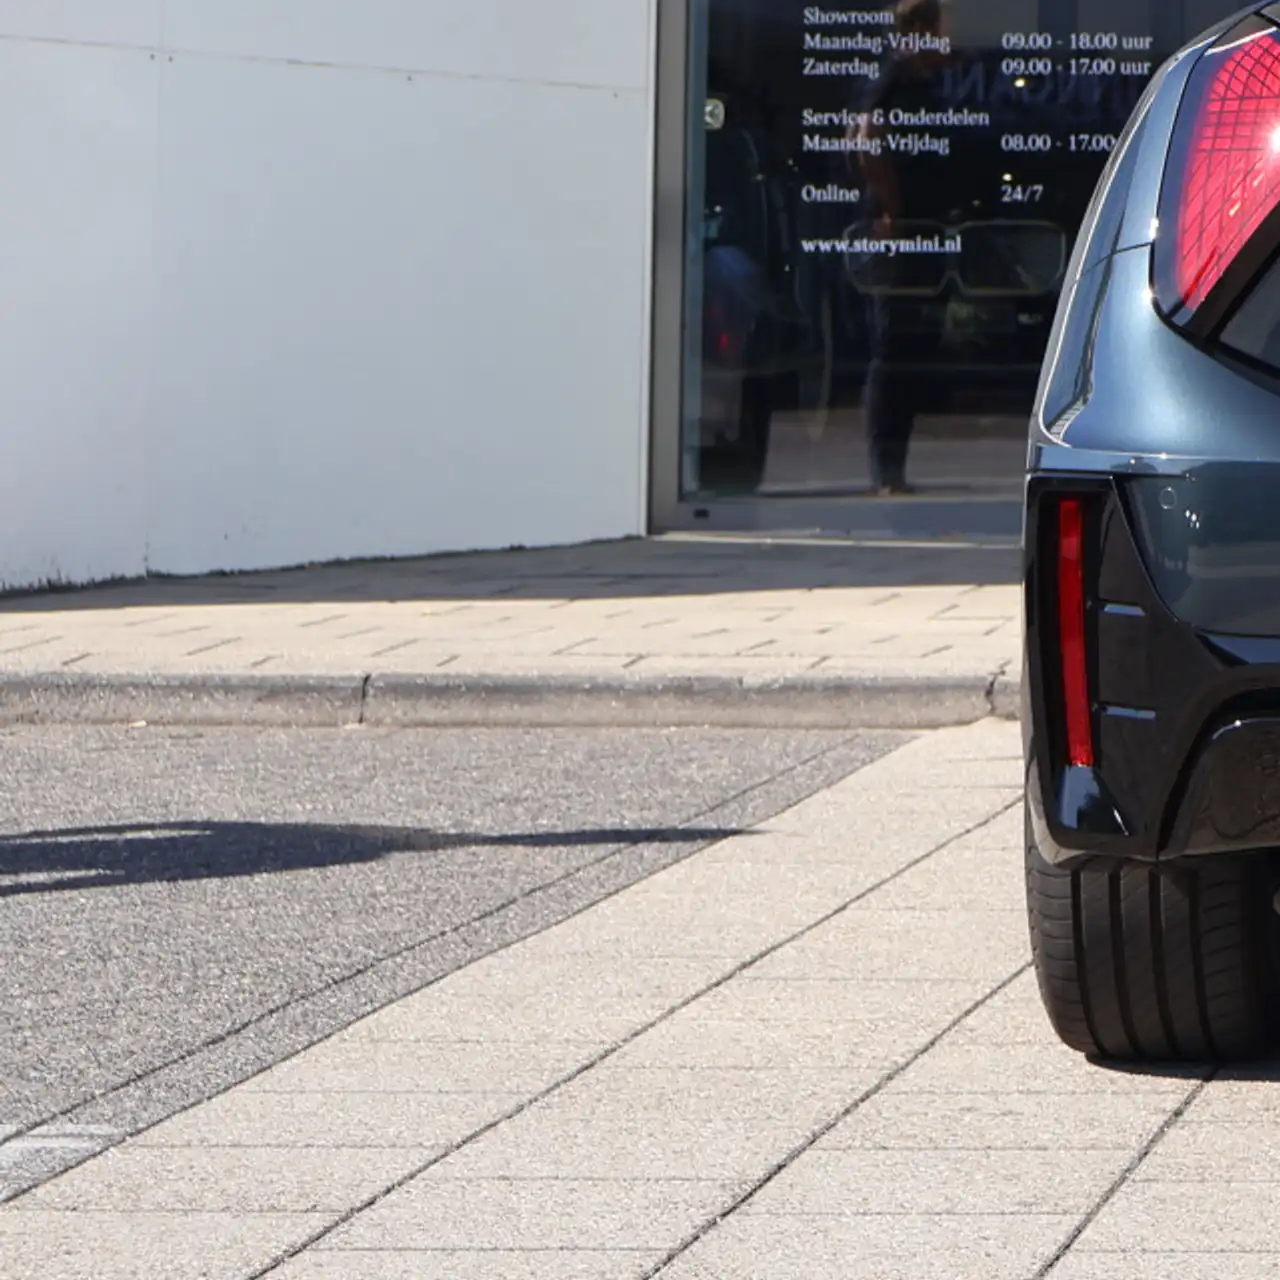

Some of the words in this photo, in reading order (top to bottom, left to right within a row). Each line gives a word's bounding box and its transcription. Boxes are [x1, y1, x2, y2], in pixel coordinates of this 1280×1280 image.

[804, 8, 894, 25] Showroom
[804, 33, 950, 53] Maandag-Vrijdag
[1001, 33, 1052, 50] 09.00
[1070, 33, 1117, 50] 18.00
[1122, 35, 1153, 50] uur
[803, 59, 880, 78] Zaterdag
[1001, 58, 1052, 75] 09.00
[1069, 58, 1116, 75] 17.00
[1120, 61, 1152, 75] uur
[802, 109, 867, 127] Service
[873, 109, 885, 126] &
[889, 109, 989, 127] Onderdelen
[802, 134, 950, 155] Maandag-Vrijdag
[1001, 134, 1051, 152] 08.00
[1068, 134, 1116, 152] 17.00
[802, 185, 859, 202] Online
[1001, 185, 1043, 202] 24/7
[801, 236, 962, 254] www.storymini.nl
